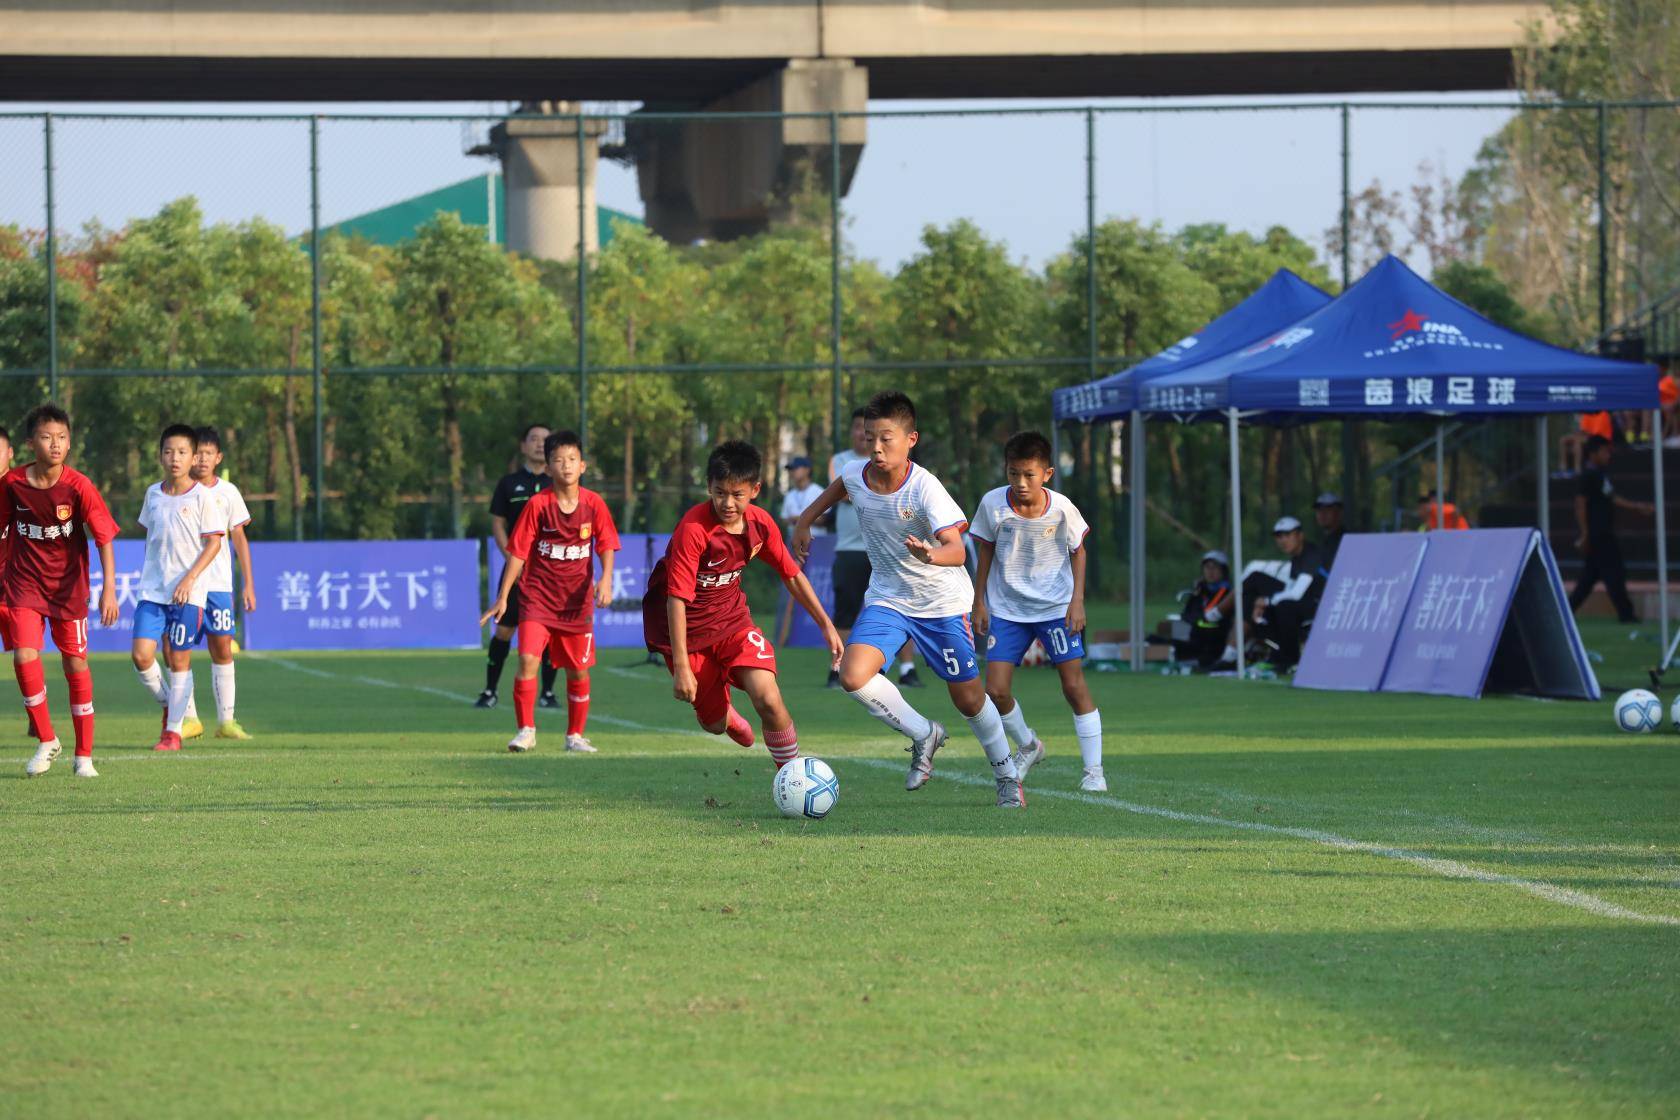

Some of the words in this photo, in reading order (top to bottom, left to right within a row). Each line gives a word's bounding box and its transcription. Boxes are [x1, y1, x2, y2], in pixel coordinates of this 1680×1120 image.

[277, 570, 430, 611] 善行天下
[1414, 574, 1497, 632] 善行天下
[213, 609, 231, 631] 36
[584, 633, 593, 657] 7
[747, 631, 766, 651] 9
[1047, 627, 1068, 656] 10
[942, 648, 960, 676] 5
